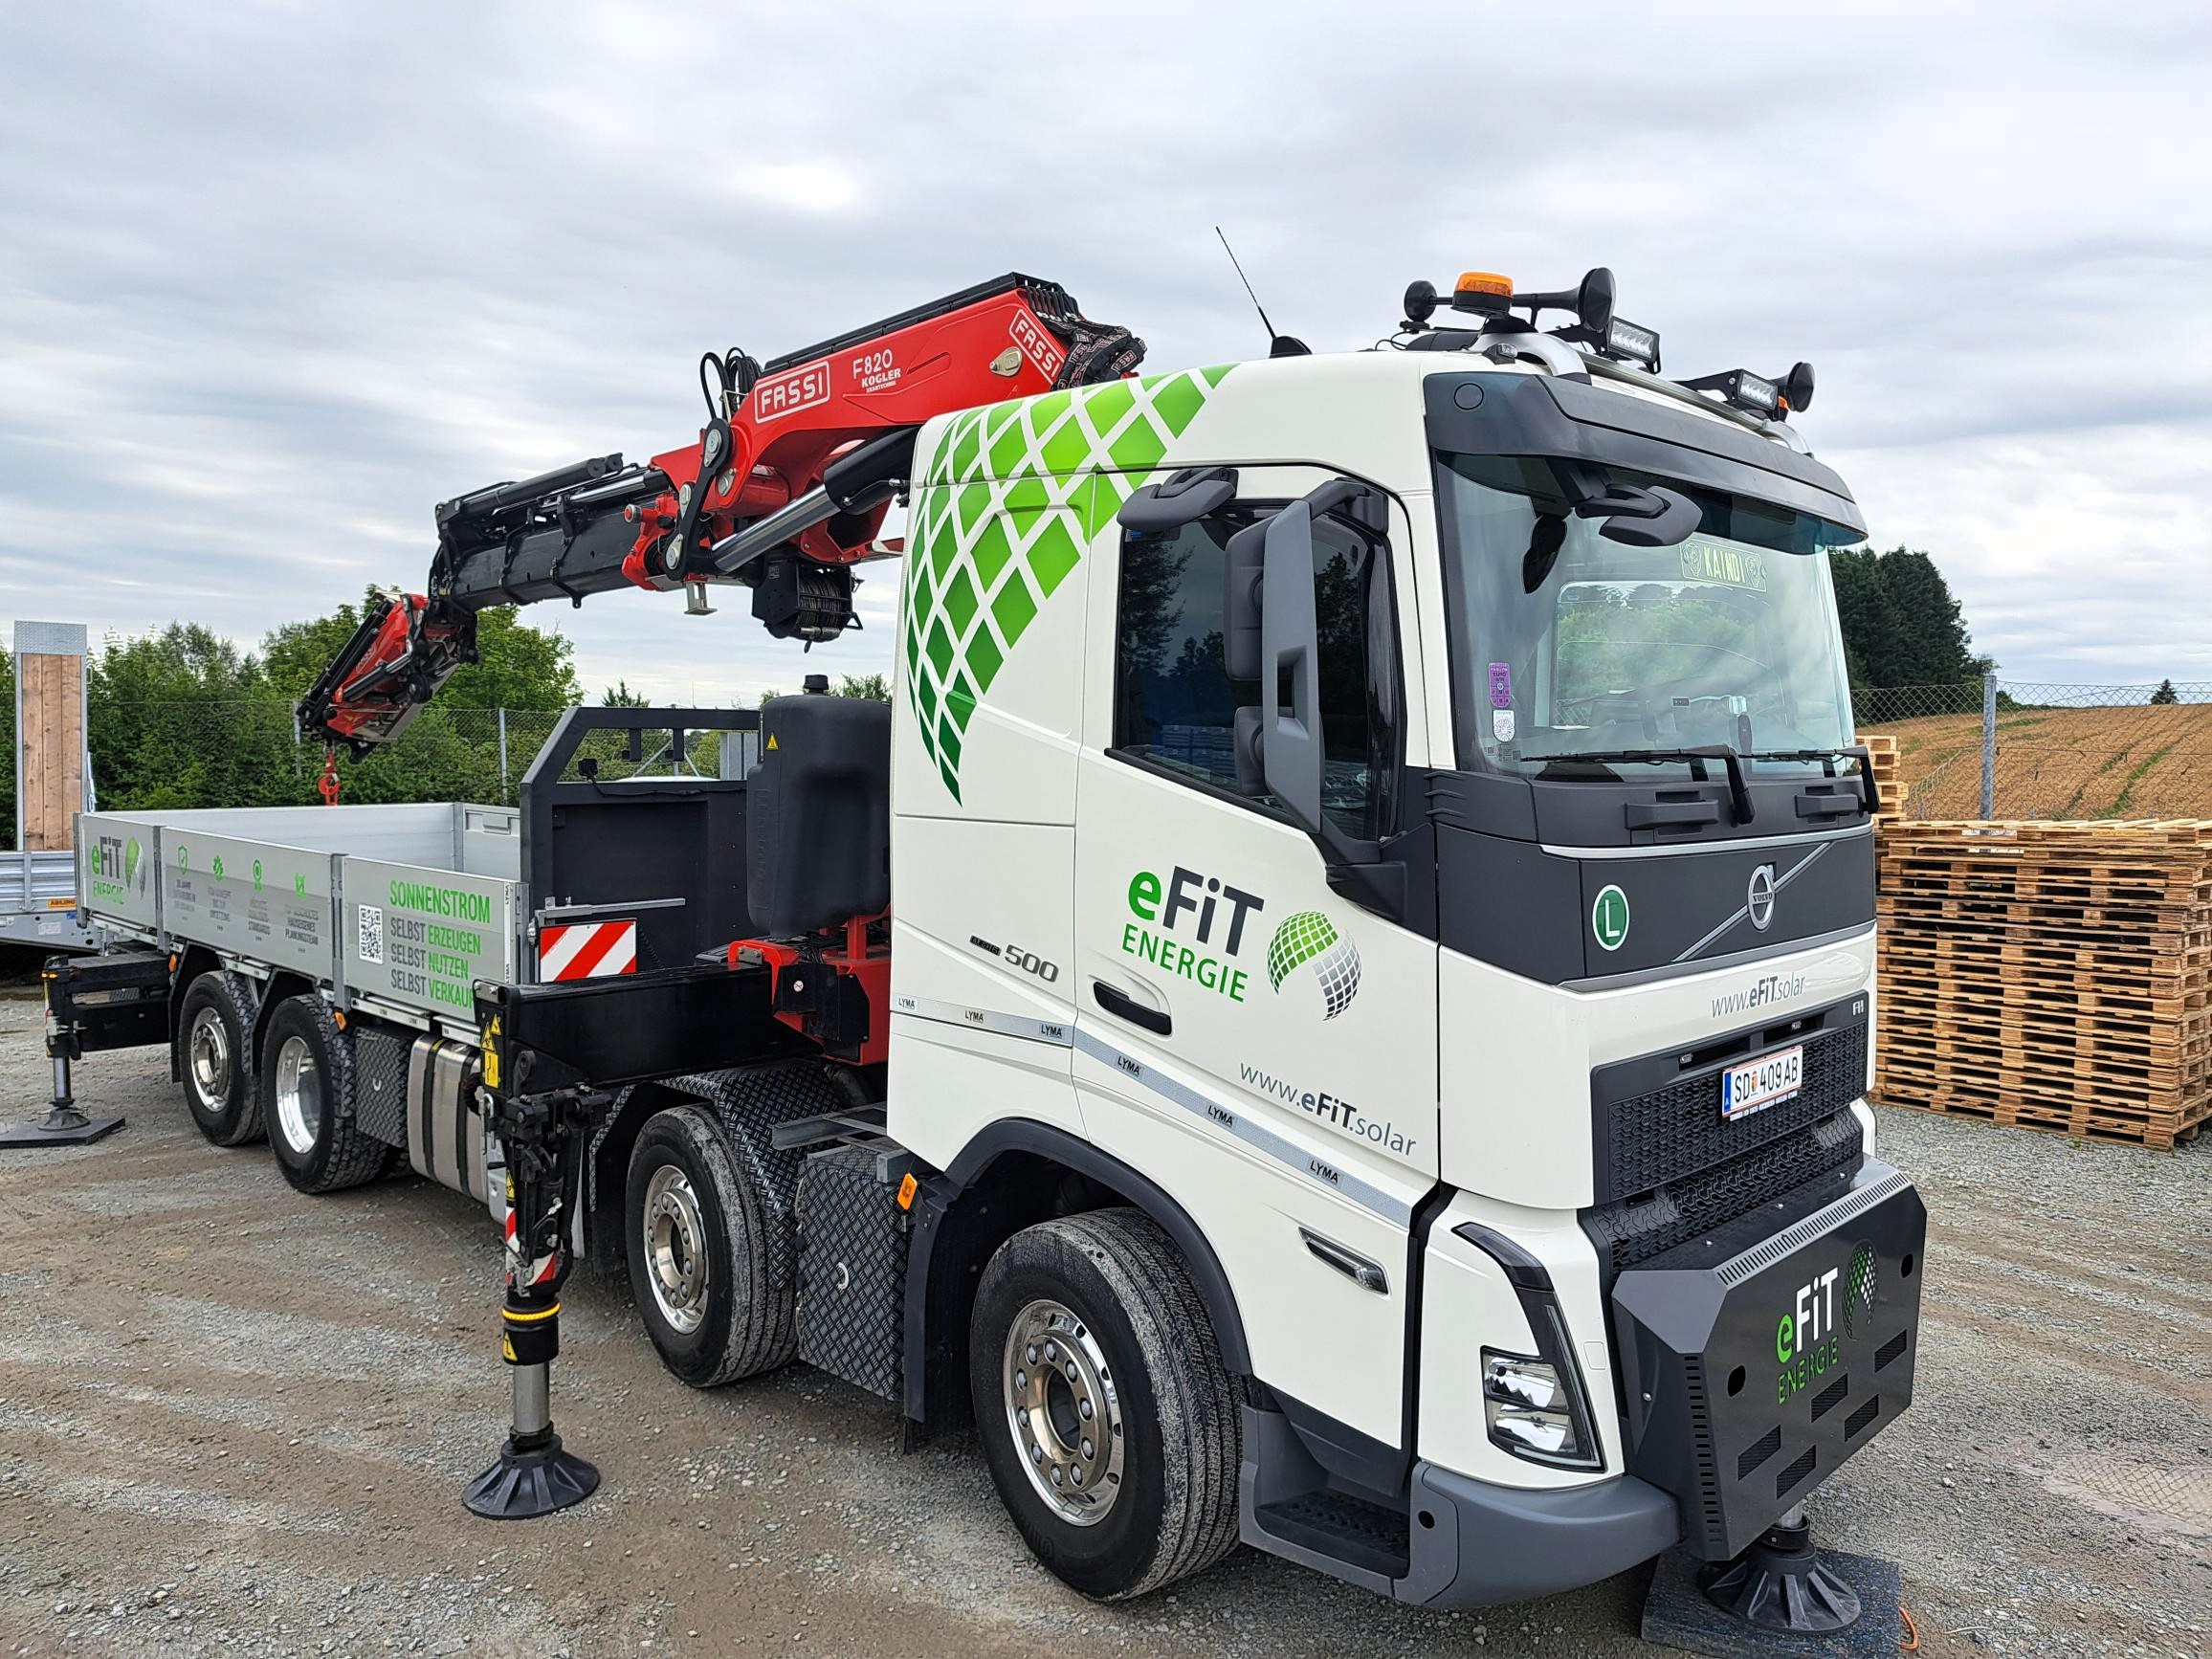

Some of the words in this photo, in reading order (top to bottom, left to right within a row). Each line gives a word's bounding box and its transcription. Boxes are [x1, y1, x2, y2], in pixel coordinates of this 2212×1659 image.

[852, 348, 893, 380] F820
[1015, 320, 1060, 378] FASSI
[762, 371, 823, 414] FASSI
[862, 368, 901, 388] KOGLER
[91, 835, 122, 879] eFiT
[389, 879, 491, 924] SONNENSTROM
[1128, 865, 1265, 958] eFiT
[1752, 892, 1773, 903] VOLVO
[390, 917, 426, 943] SELBST
[428, 924, 481, 956] ERZEUGEN
[1604, 899, 1621, 939] L
[390, 942, 427, 970] SELBST
[428, 951, 469, 981] NUTZEN
[1004, 943, 1059, 984] 500
[1121, 922, 1249, 1004] ENERGIE
[390, 968, 427, 996] SELBST
[1711, 971, 1806, 1019] www.eFiT.solar
[898, 998, 916, 1008] LYMA
[964, 1010, 984, 1022] LYMA
[1041, 1024, 1063, 1037] LYMA
[1117, 1055, 1141, 1076] LYMA
[1734, 1073, 1751, 1103] SD
[1759, 1063, 1781, 1091] 409
[1783, 1055, 1799, 1084] AB
[1207, 1104, 1234, 1127] LYMA
[1239, 1062, 1417, 1157] www.eFiT.solar
[1310, 1160, 1339, 1183] LYMA
[1775, 1266, 1839, 1363] eFiT
[1777, 1336, 1840, 1405] ENERGIE
